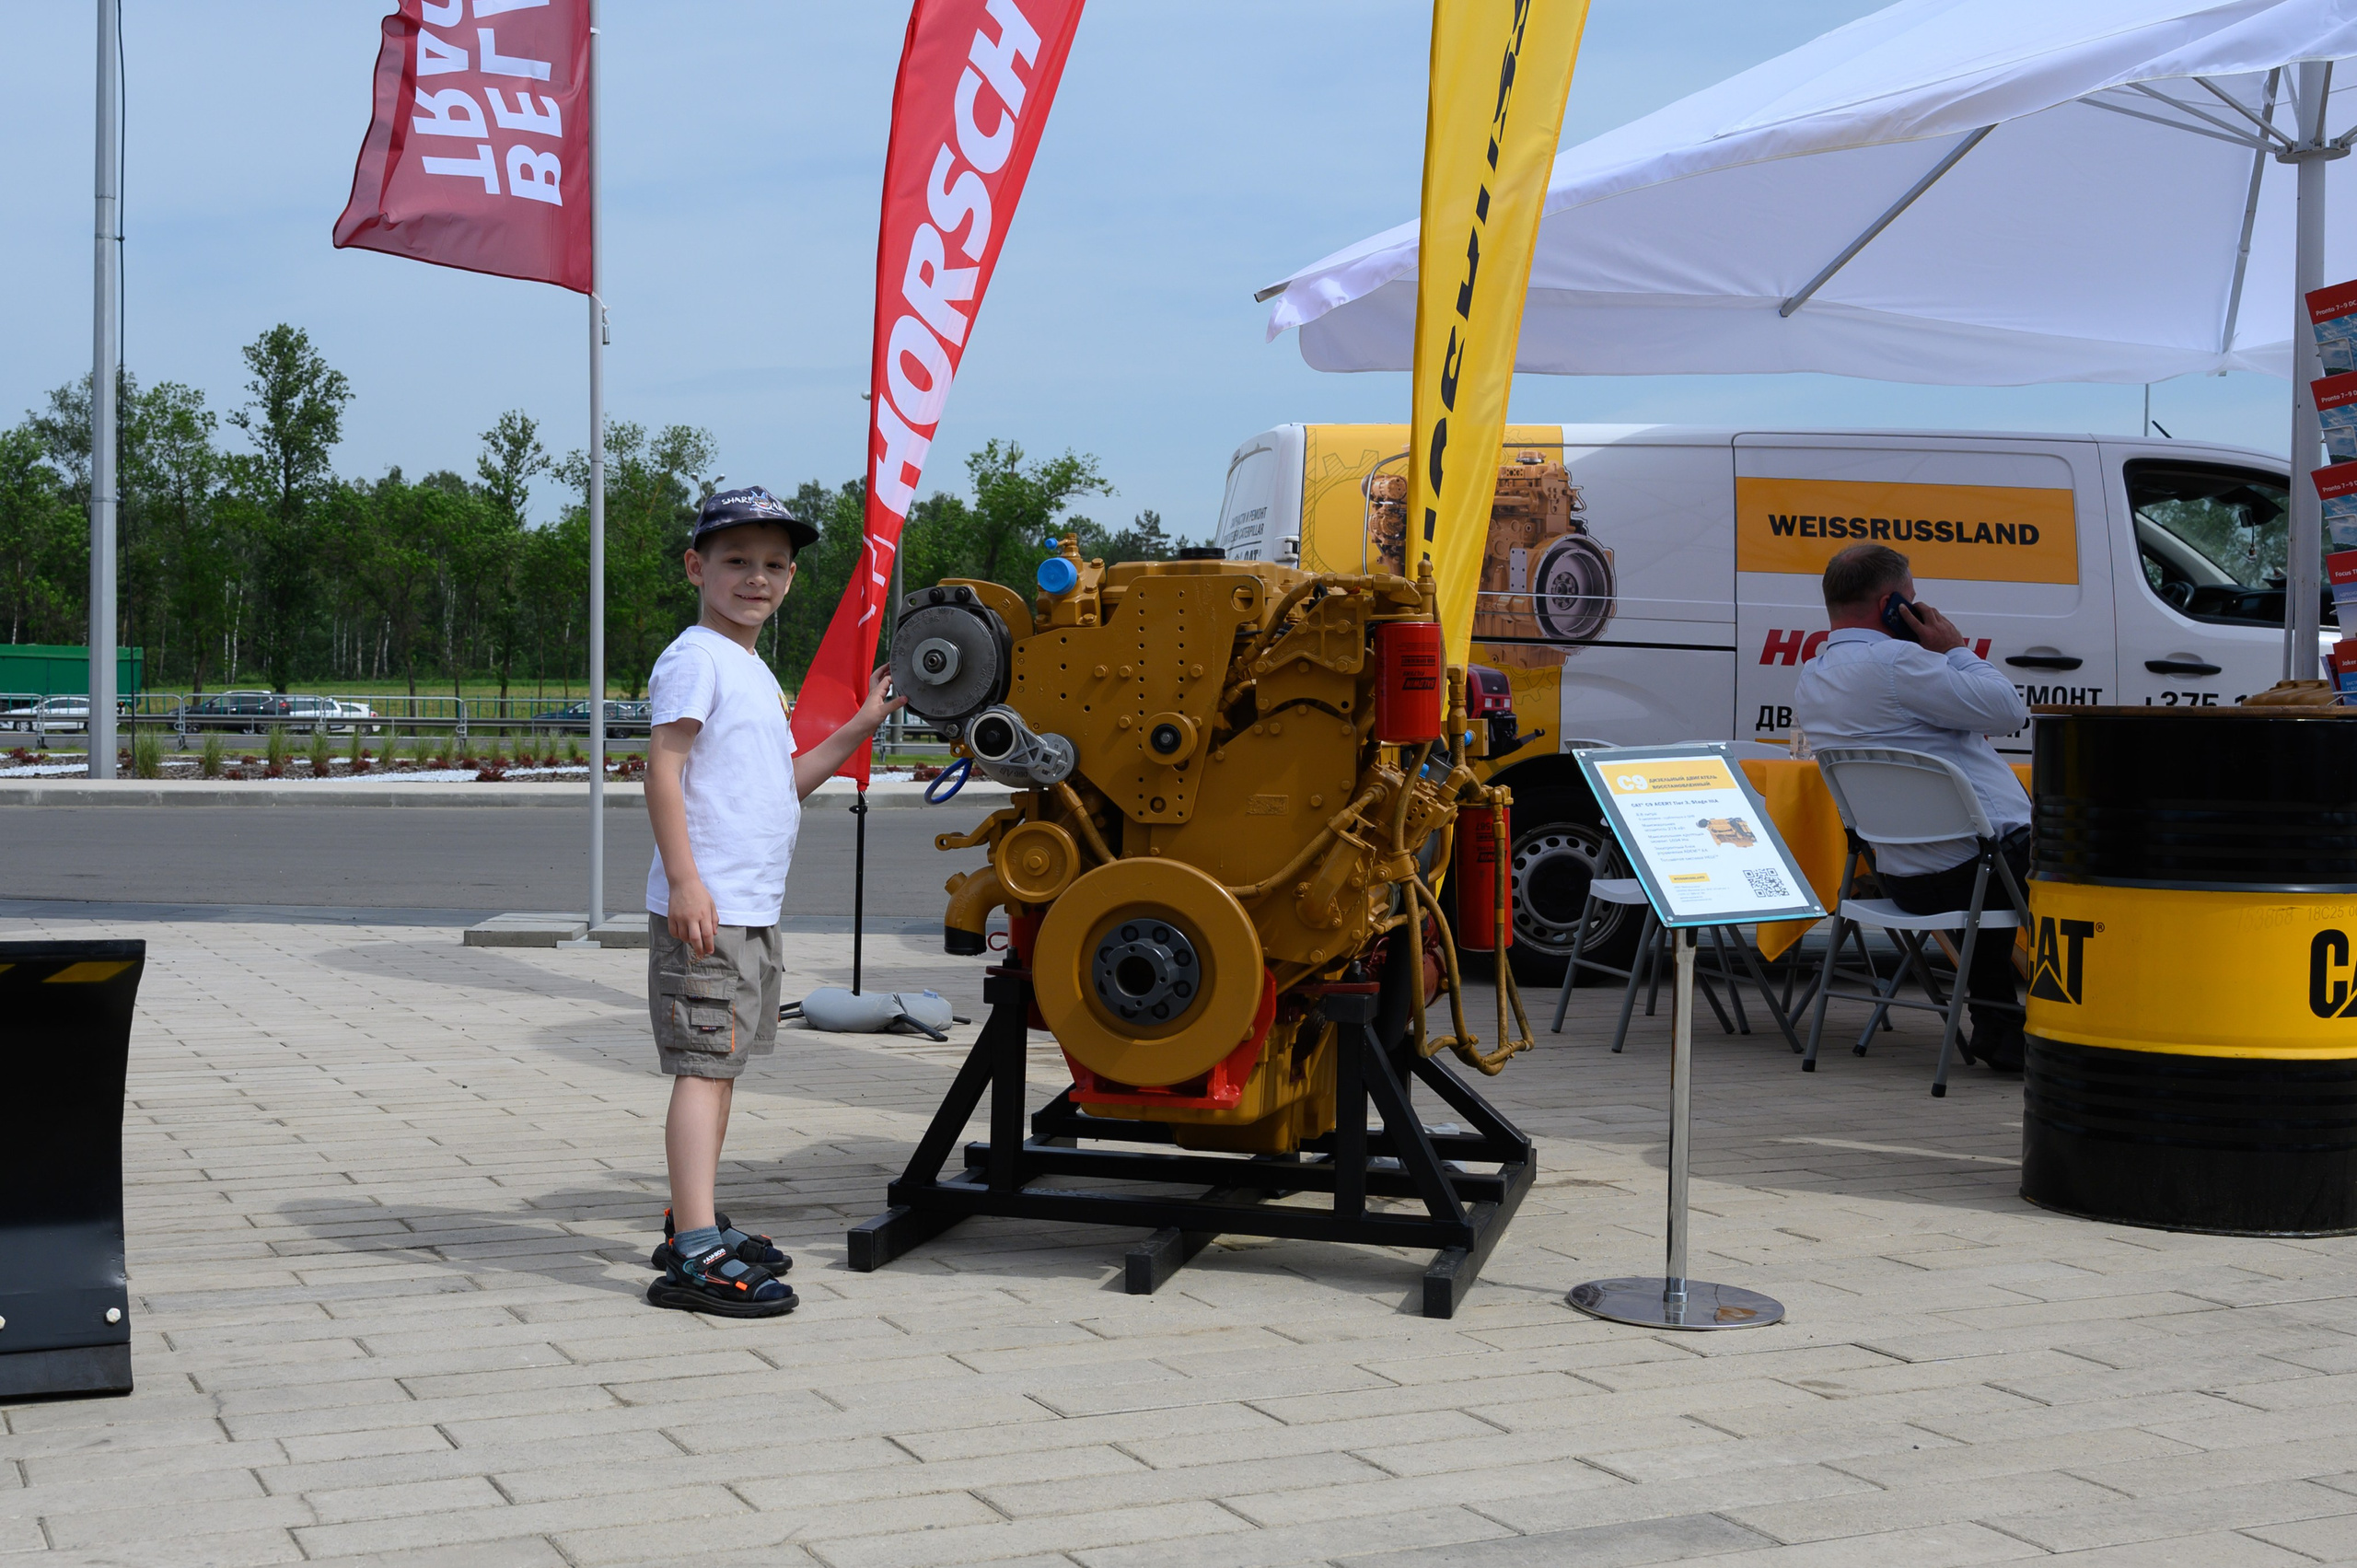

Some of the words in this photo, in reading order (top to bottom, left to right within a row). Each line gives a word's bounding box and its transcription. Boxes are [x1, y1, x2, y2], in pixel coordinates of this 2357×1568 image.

[876, 0, 1041, 519] HORSCH
[2316, 307, 2335, 316] Pronto
[2321, 395, 2340, 403] Pronto
[1768, 514, 2039, 545] WEISSRUSSLAND
[1617, 774, 1648, 791] C9
[1649, 775, 1685, 784] ДИЗЕЛЬНЫЙ
[1652, 782, 1711, 790] ВОССТАНОВЛЕННЫЙ
[2306, 906, 2344, 922] 18C25
